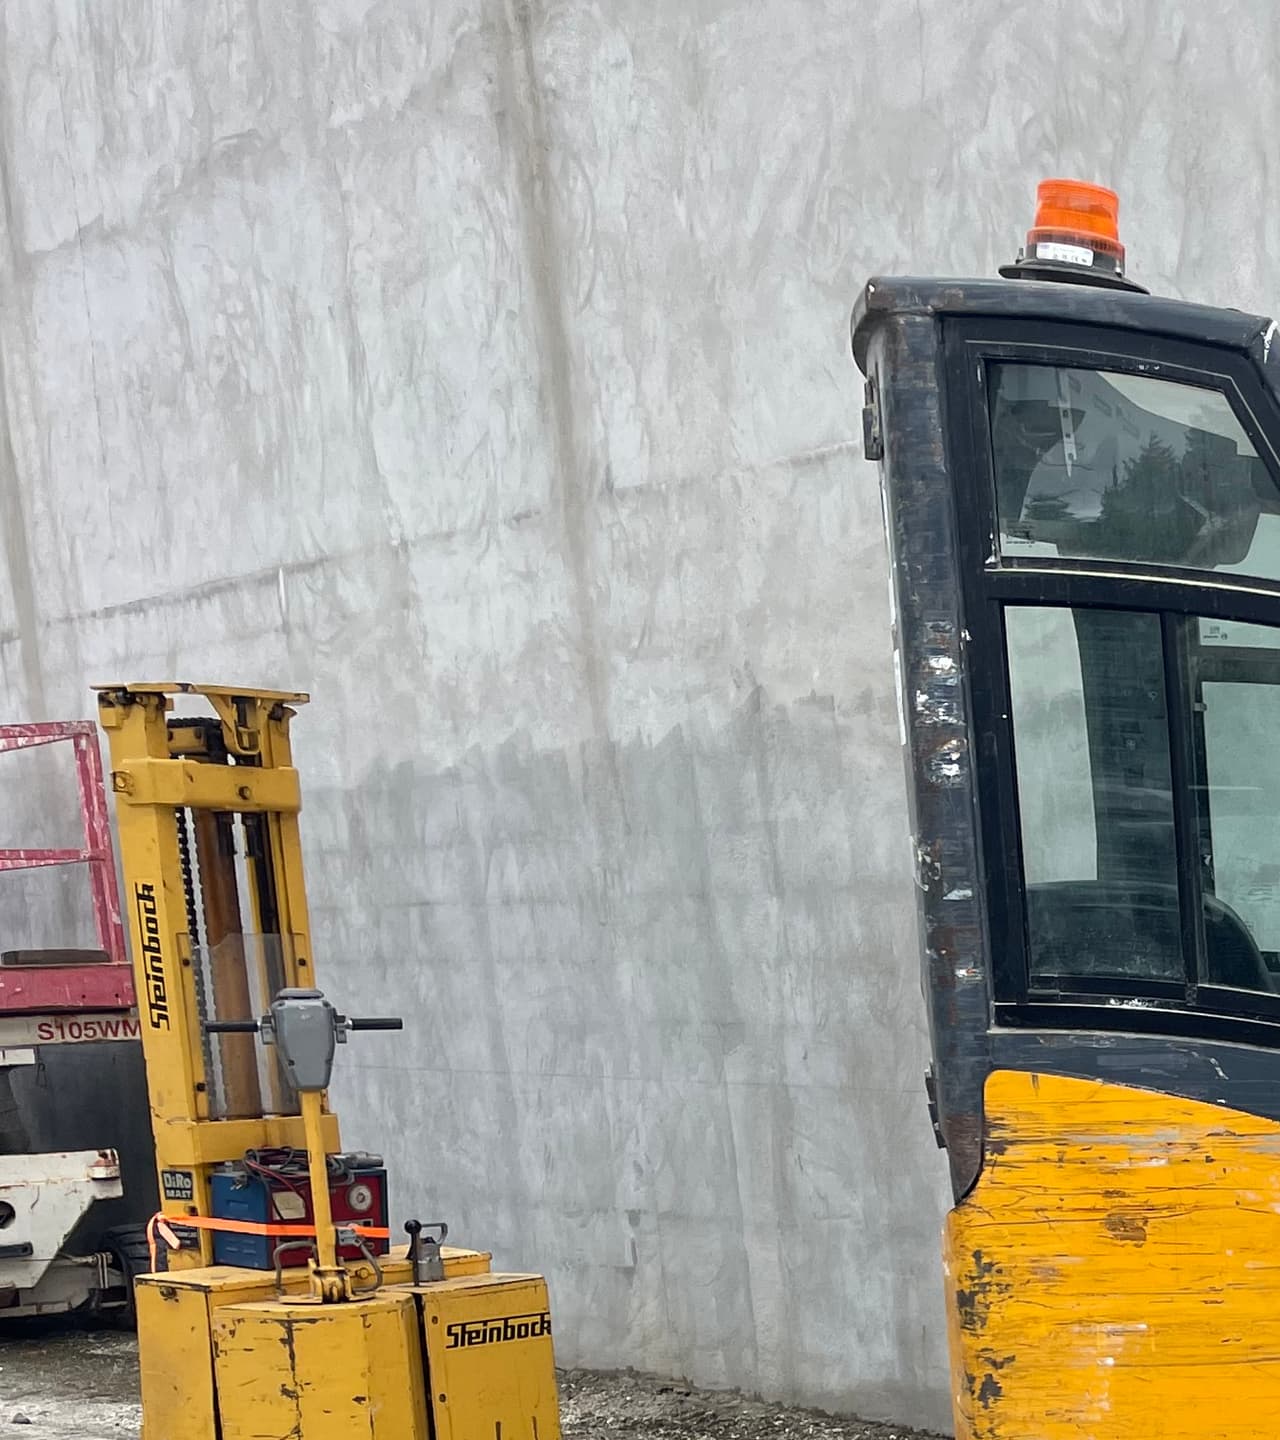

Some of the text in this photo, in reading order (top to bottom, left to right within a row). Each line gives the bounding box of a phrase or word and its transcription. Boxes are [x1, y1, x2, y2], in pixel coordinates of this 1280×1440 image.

[134, 882, 170, 1031] Steinbock
[37, 1019, 141, 1041] S105WM
[445, 1311, 553, 1349] Steinbock
